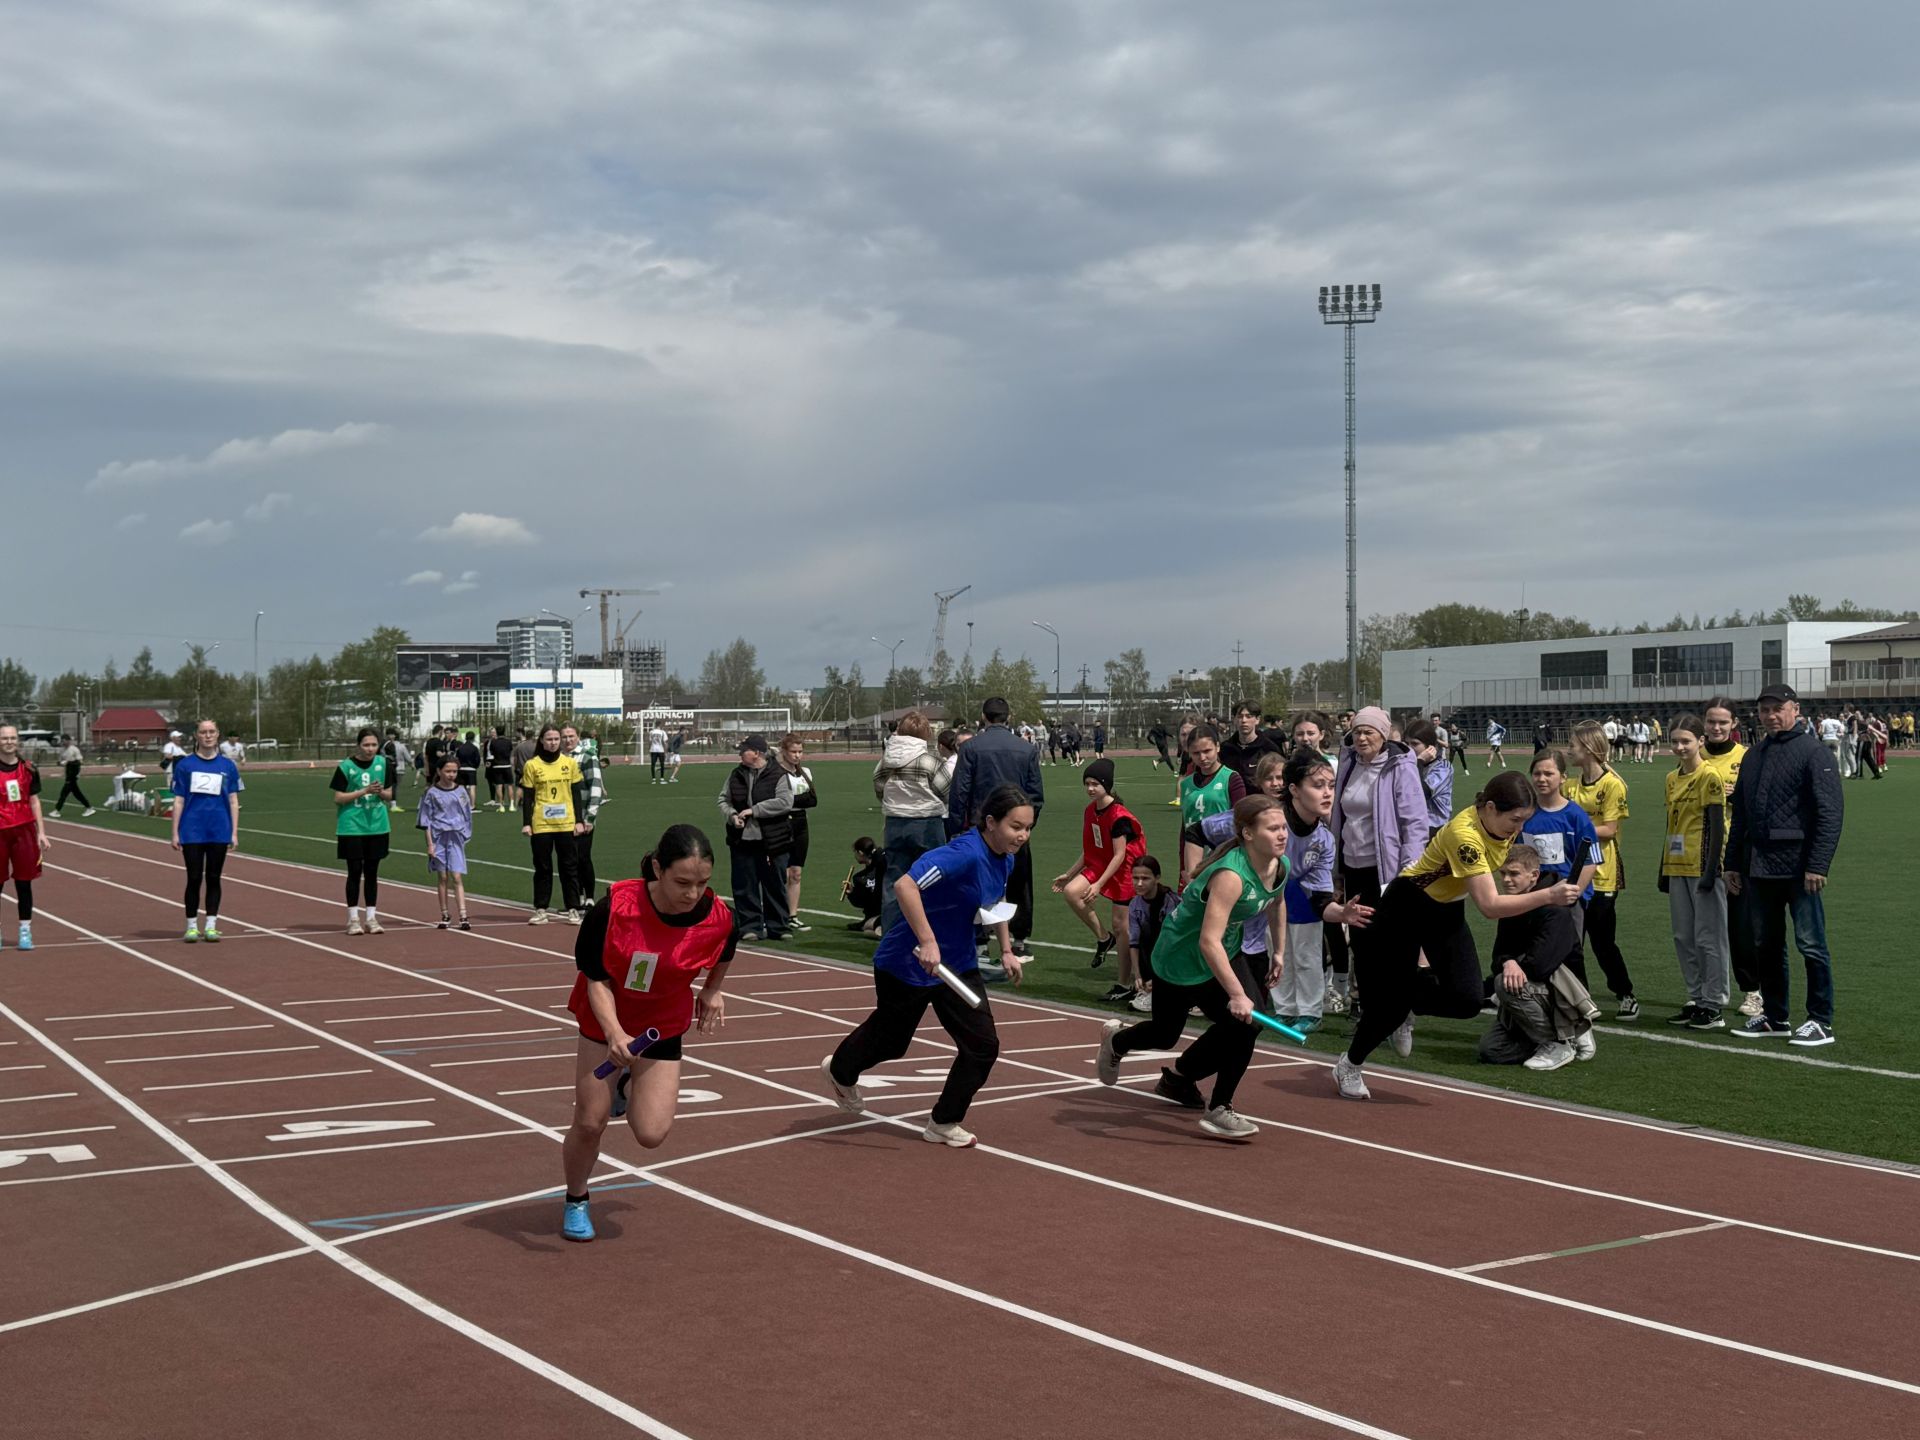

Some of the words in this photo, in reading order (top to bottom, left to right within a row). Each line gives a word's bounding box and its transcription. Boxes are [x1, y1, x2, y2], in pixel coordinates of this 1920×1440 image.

[551, 787, 557, 800] 9
[1195, 794, 1205, 813] 4
[630, 960, 648, 990] 1
[265, 1120, 436, 1142] 4
